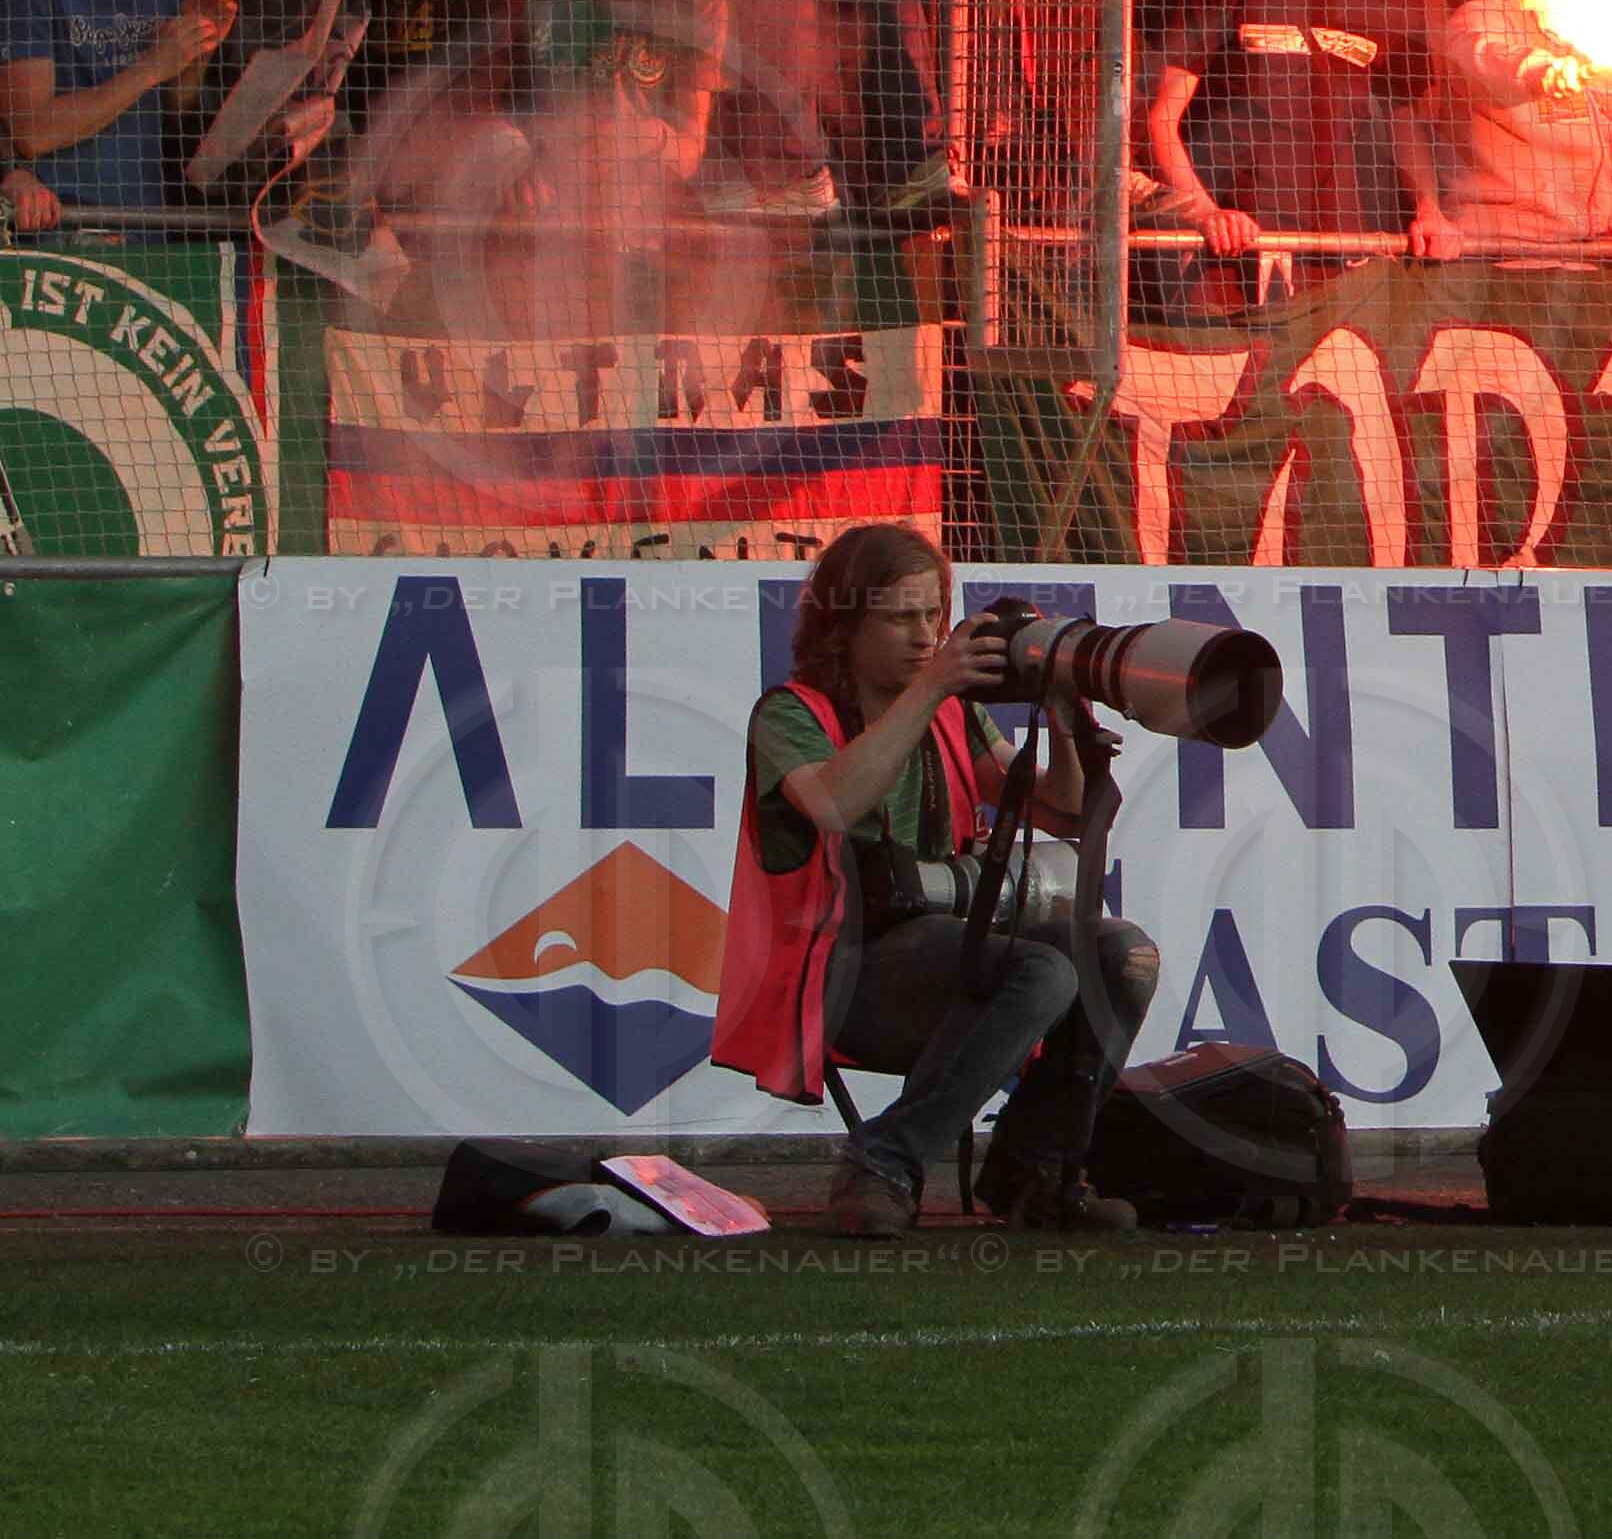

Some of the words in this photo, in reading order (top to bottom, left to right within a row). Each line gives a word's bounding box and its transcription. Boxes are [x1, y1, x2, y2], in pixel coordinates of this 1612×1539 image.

[21, 267, 105, 325] IST
[109, 304, 216, 417] KEIN
[400, 334, 870, 428] ULTRAS
